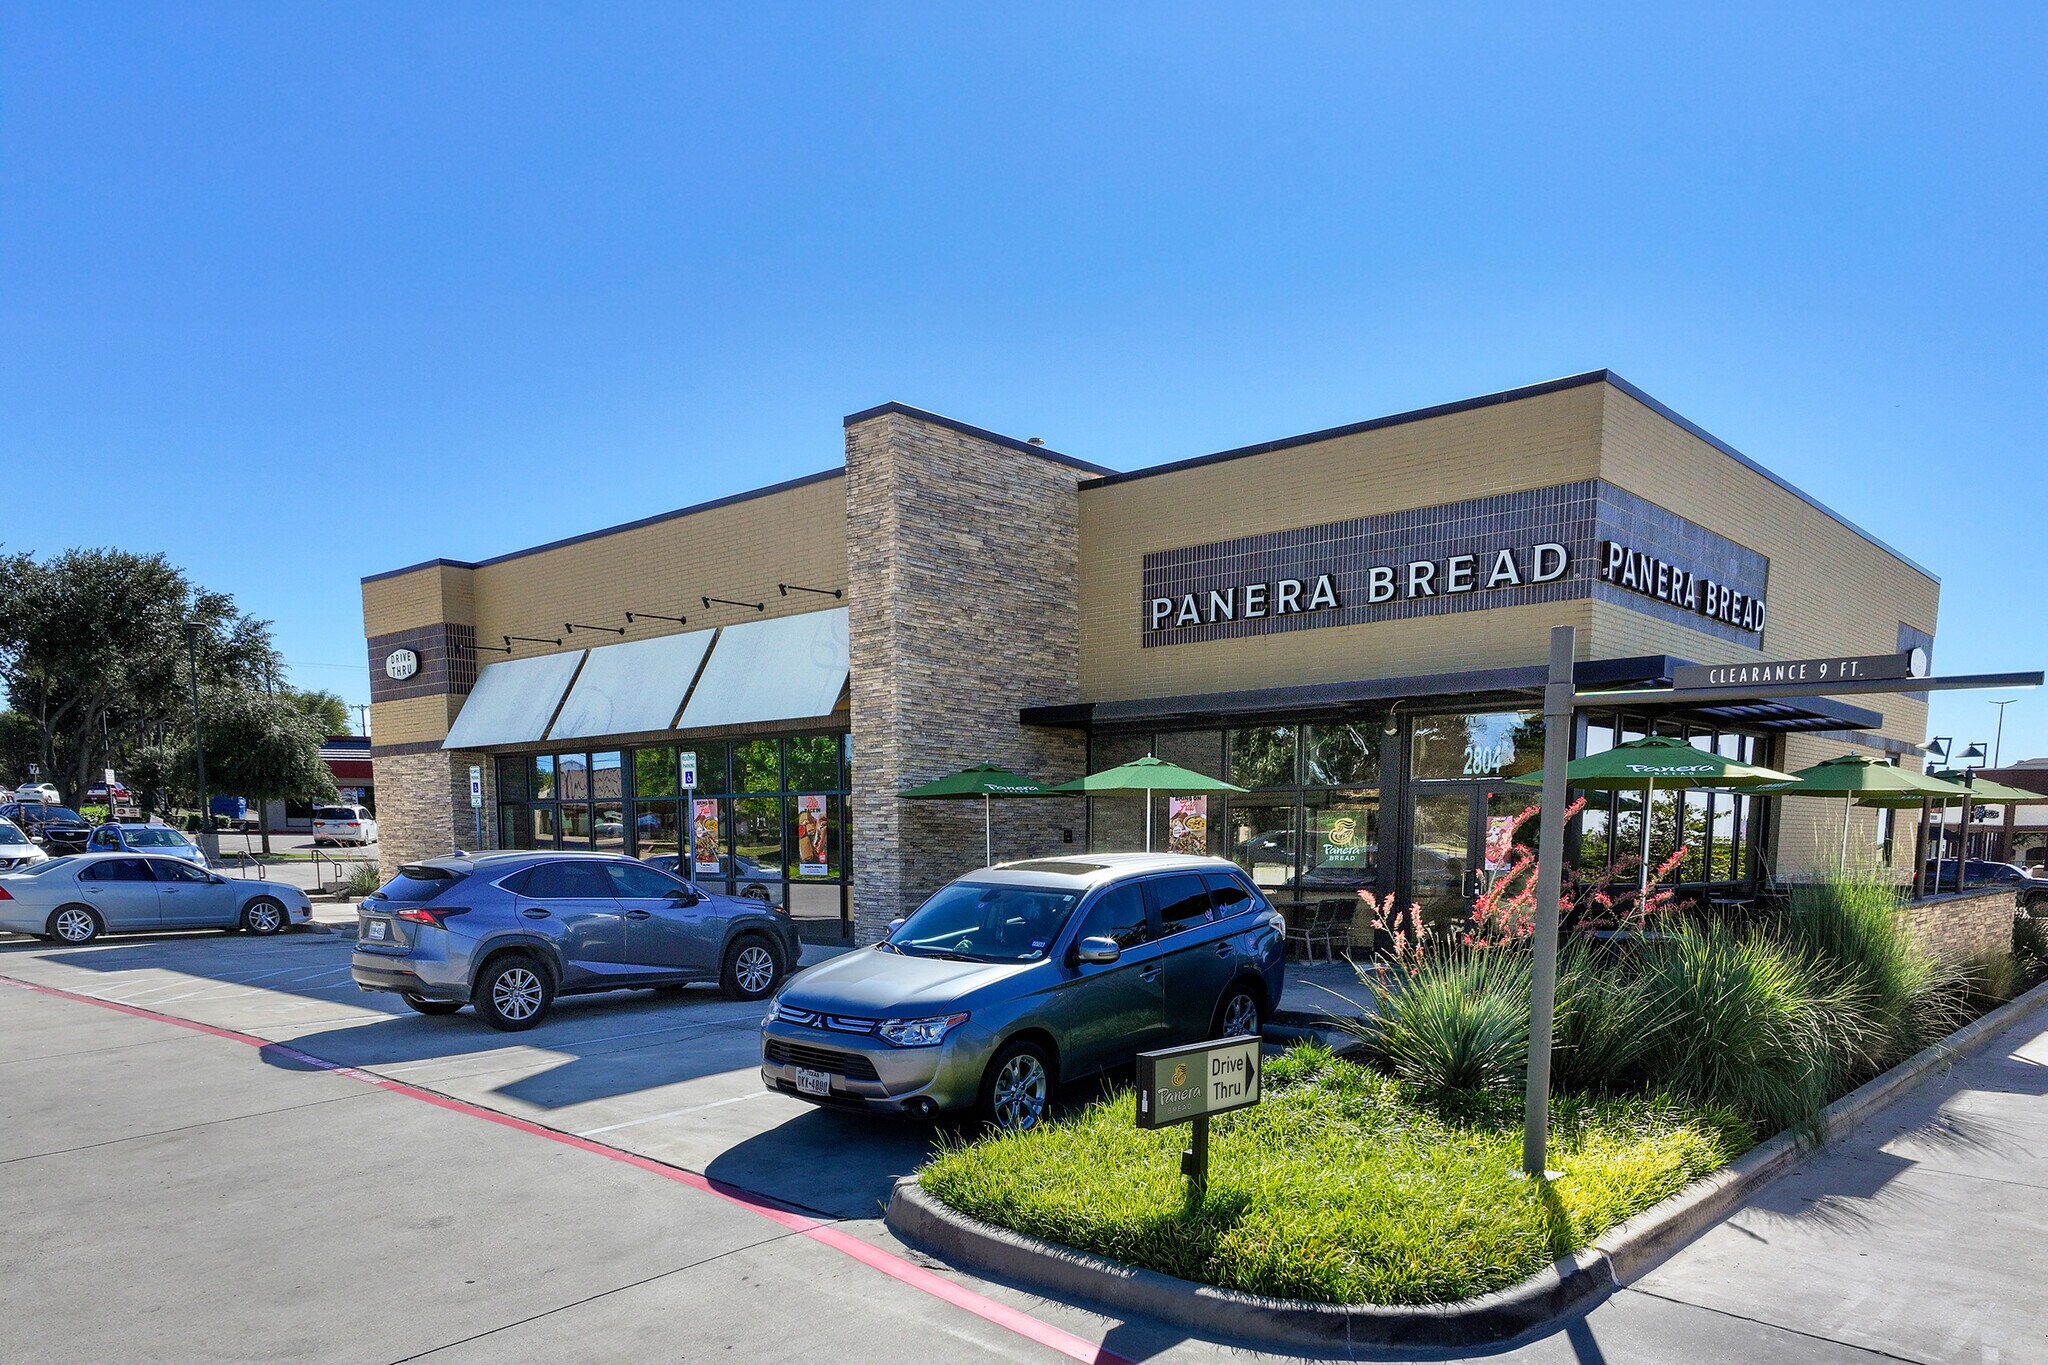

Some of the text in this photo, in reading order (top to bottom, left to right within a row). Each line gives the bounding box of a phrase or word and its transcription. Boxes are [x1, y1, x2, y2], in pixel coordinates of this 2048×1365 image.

[1151, 542, 1570, 630] PANERA BREAD
[1606, 540, 1767, 633] PANERA BREAD
[390, 651, 411, 665] DRIVE
[392, 664, 412, 677] THRU
[1709, 660, 1865, 685] CLEARANCE 9 FT.
[1462, 745, 1502, 775] 2804
[1626, 764, 1716, 773] Panera
[983, 783, 1040, 791] Panera
[1322, 843, 1361, 855] Panera
[1212, 1056, 1244, 1076] Drive
[1157, 1086, 1202, 1106] Panera
[1213, 1082, 1241, 1100] Thru
[1167, 1102, 1192, 1113] BREAD
